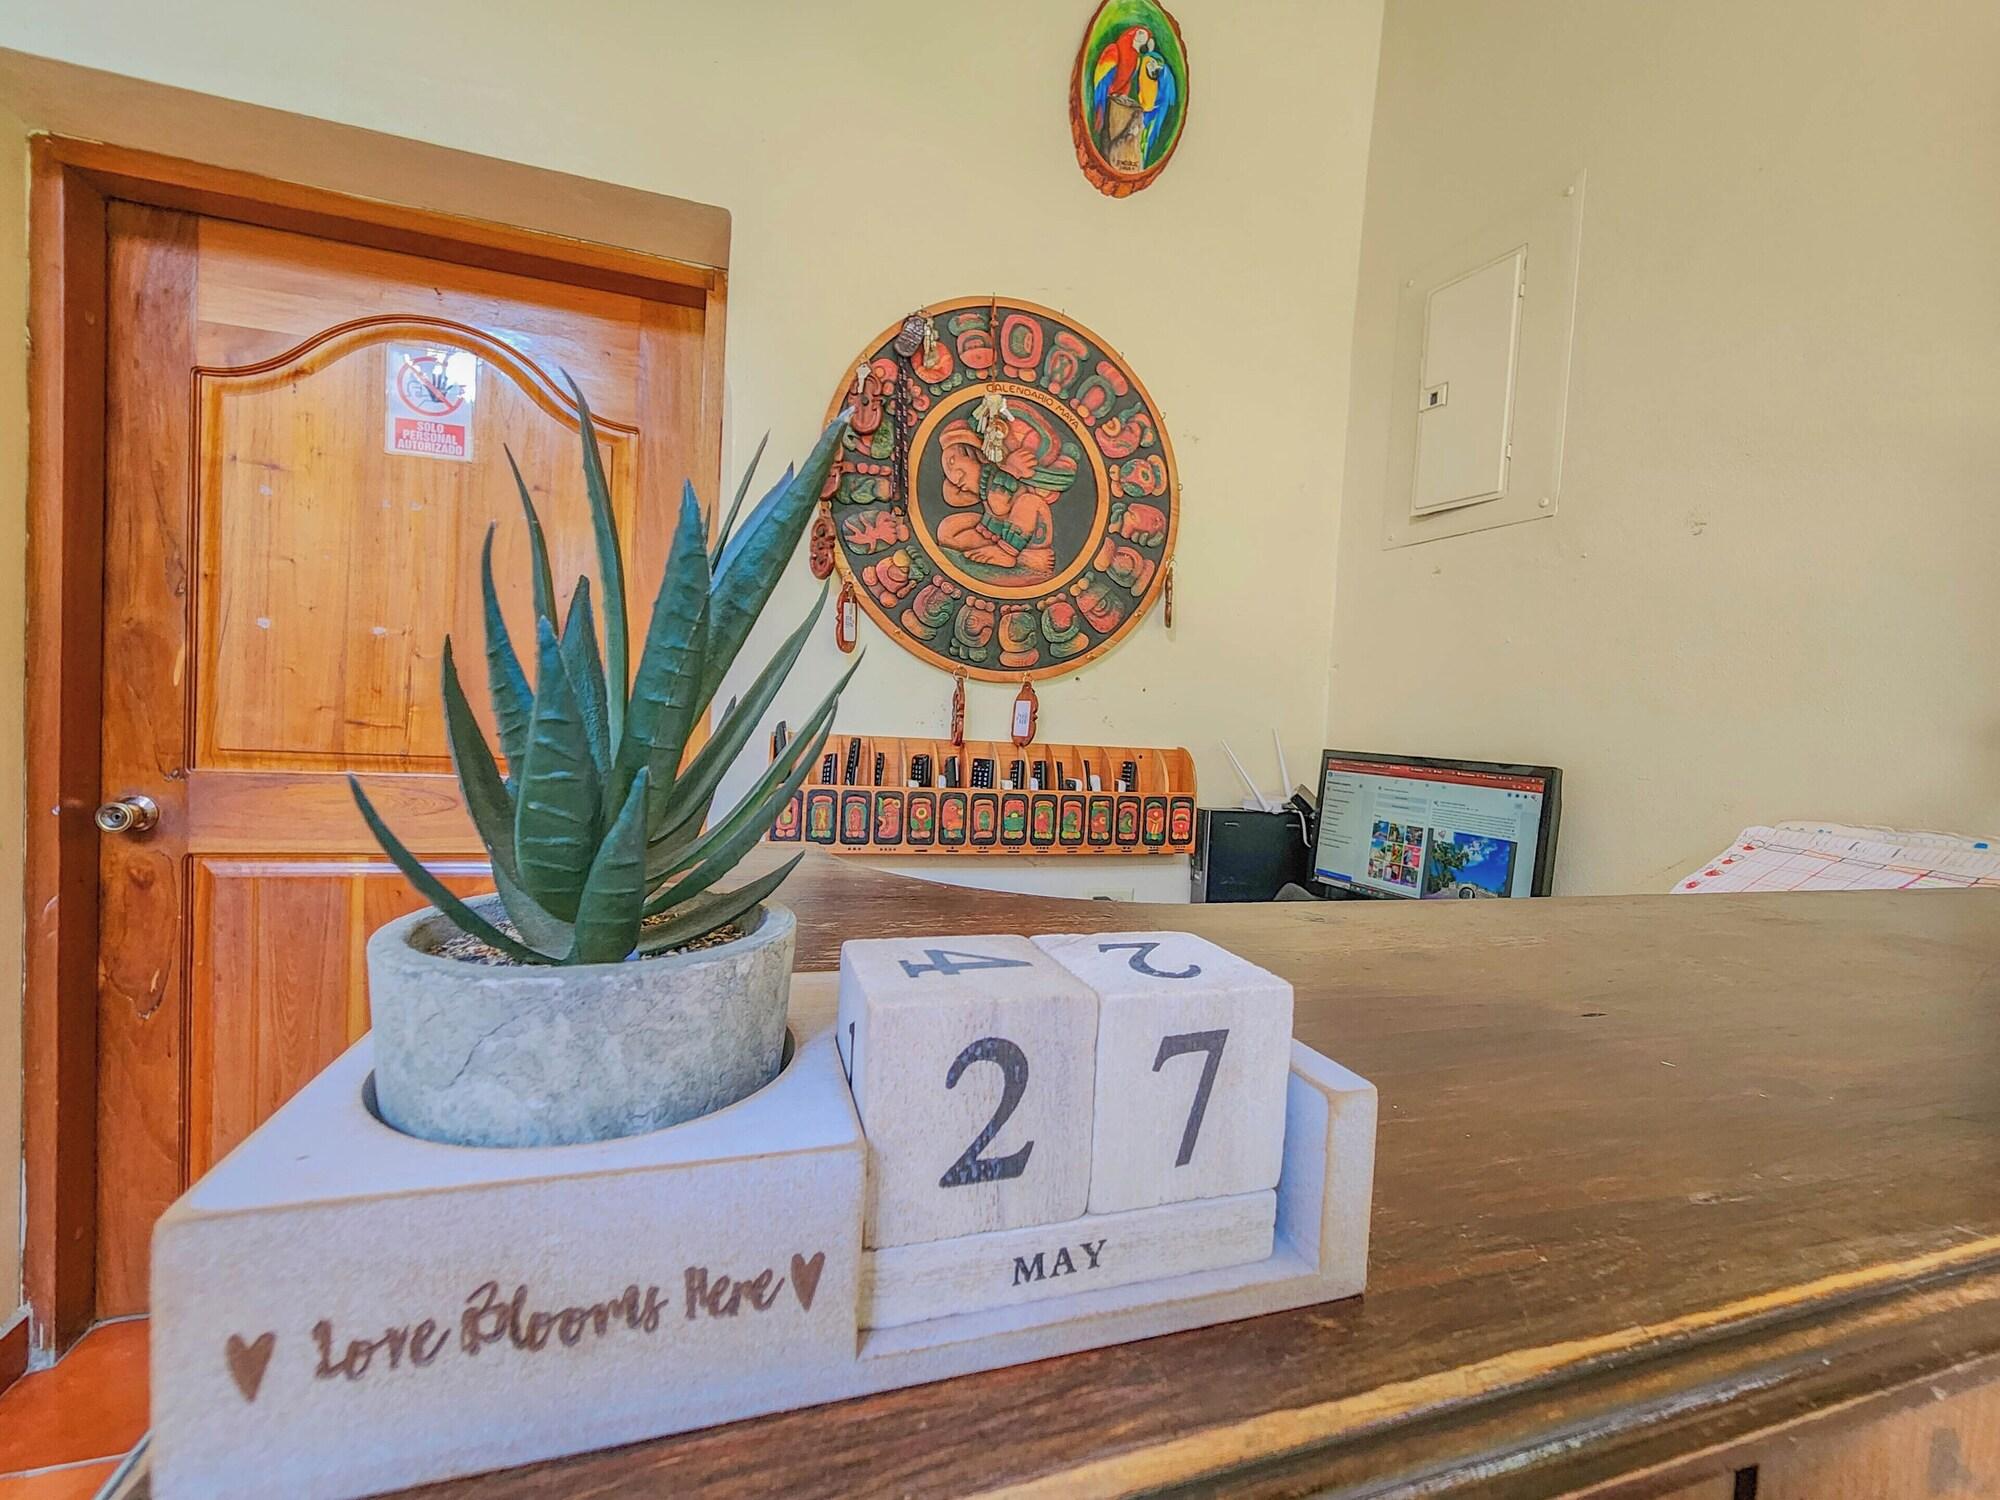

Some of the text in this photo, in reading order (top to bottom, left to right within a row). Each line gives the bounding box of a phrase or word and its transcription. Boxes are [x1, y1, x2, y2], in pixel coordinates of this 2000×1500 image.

[985, 383, 1079, 429] CALENDARIO MAYA
[402, 428, 458, 445] PERSONAL
[416, 421, 445, 433] SOLO
[397, 438, 463, 455] AUTORIZADO
[898, 949, 1033, 978] 4
[1011, 1239, 1107, 1286] MAY
[312, 1266, 785, 1380] Love Blooms Here
